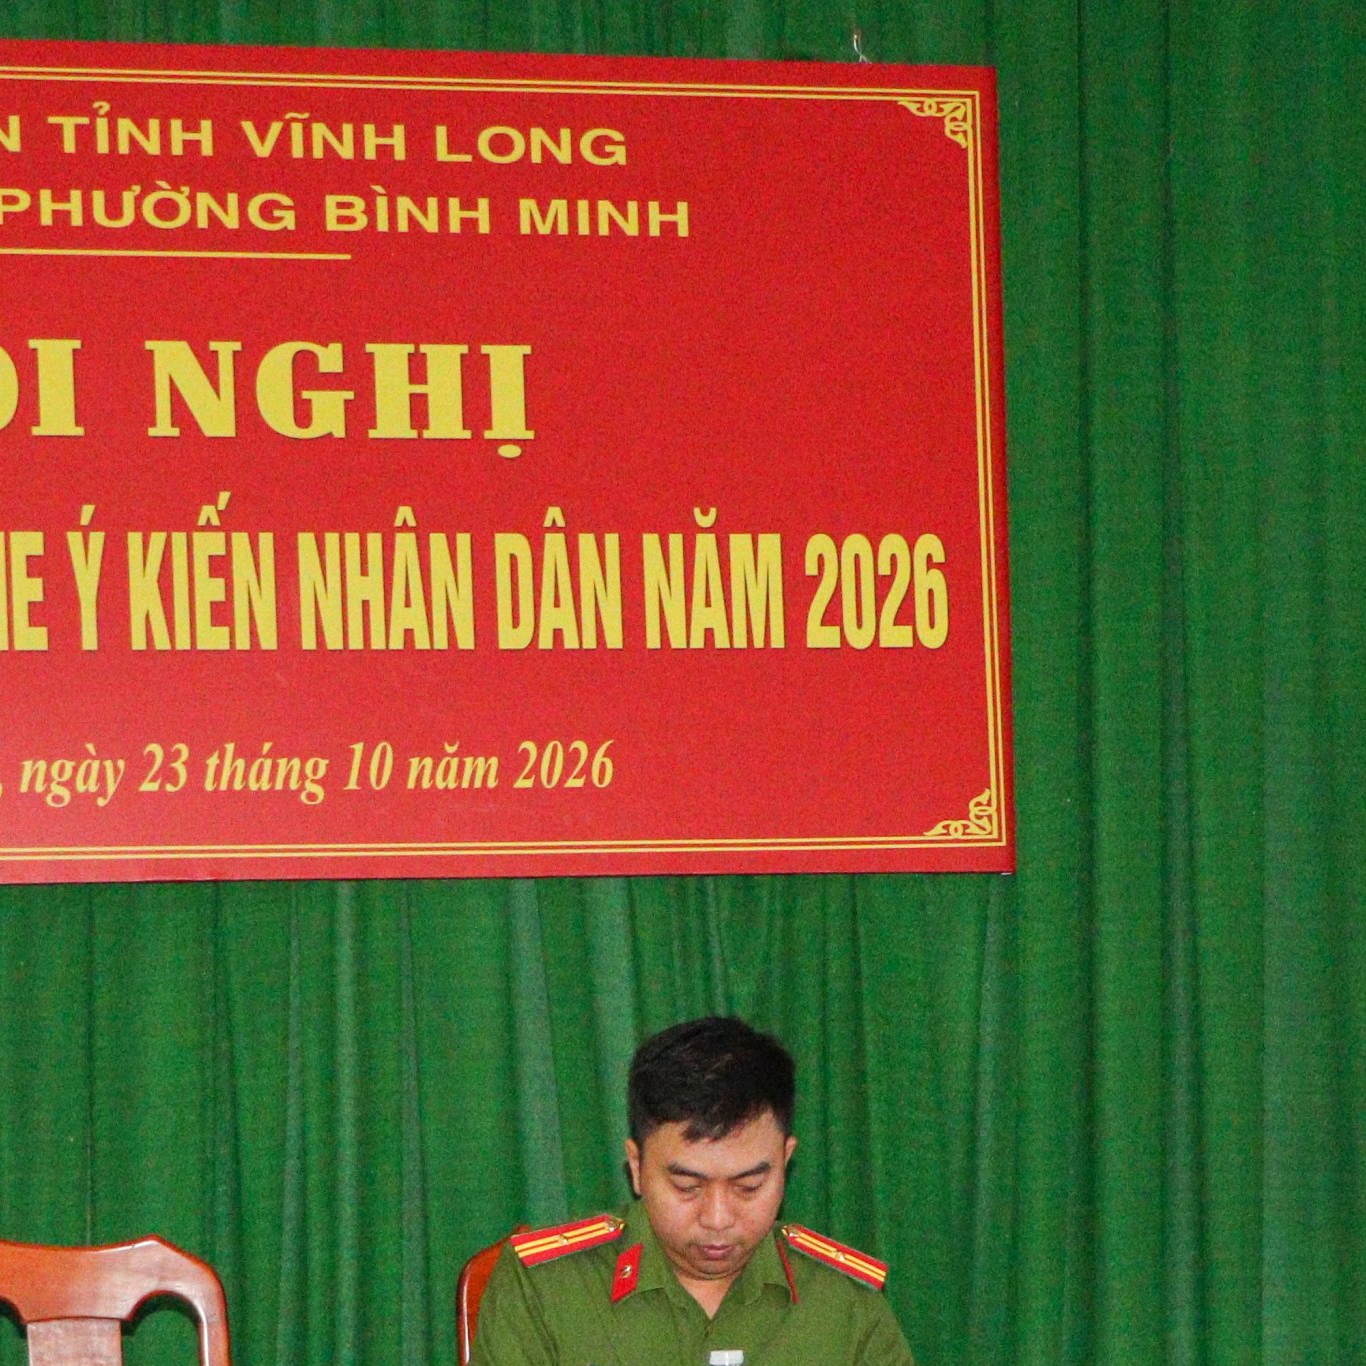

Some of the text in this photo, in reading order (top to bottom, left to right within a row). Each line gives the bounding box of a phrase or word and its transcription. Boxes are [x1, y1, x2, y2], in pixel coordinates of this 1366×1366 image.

[47, 101, 214, 156] TỈNH
[240, 112, 406, 161] VĨNH
[435, 125, 627, 166] LONG
[325, 184, 491, 234] BÌNH
[519, 198, 689, 237] MINH
[144, 339, 535, 459] NGHỊ
[66, 503, 106, 651] Ý
[126, 490, 278, 651] KIẾN
[297, 505, 475, 650] NHÂN
[494, 506, 624, 650] DÂN
[642, 506, 786, 650] NĂM
[804, 533, 949, 650] 2026
[18, 742, 126, 809] ngày
[137, 742, 190, 793] 23
[203, 741, 330, 806] tháng
[343, 741, 394, 791] 10
[406, 741, 499, 790] năm
[512, 739, 614, 789] 2026
